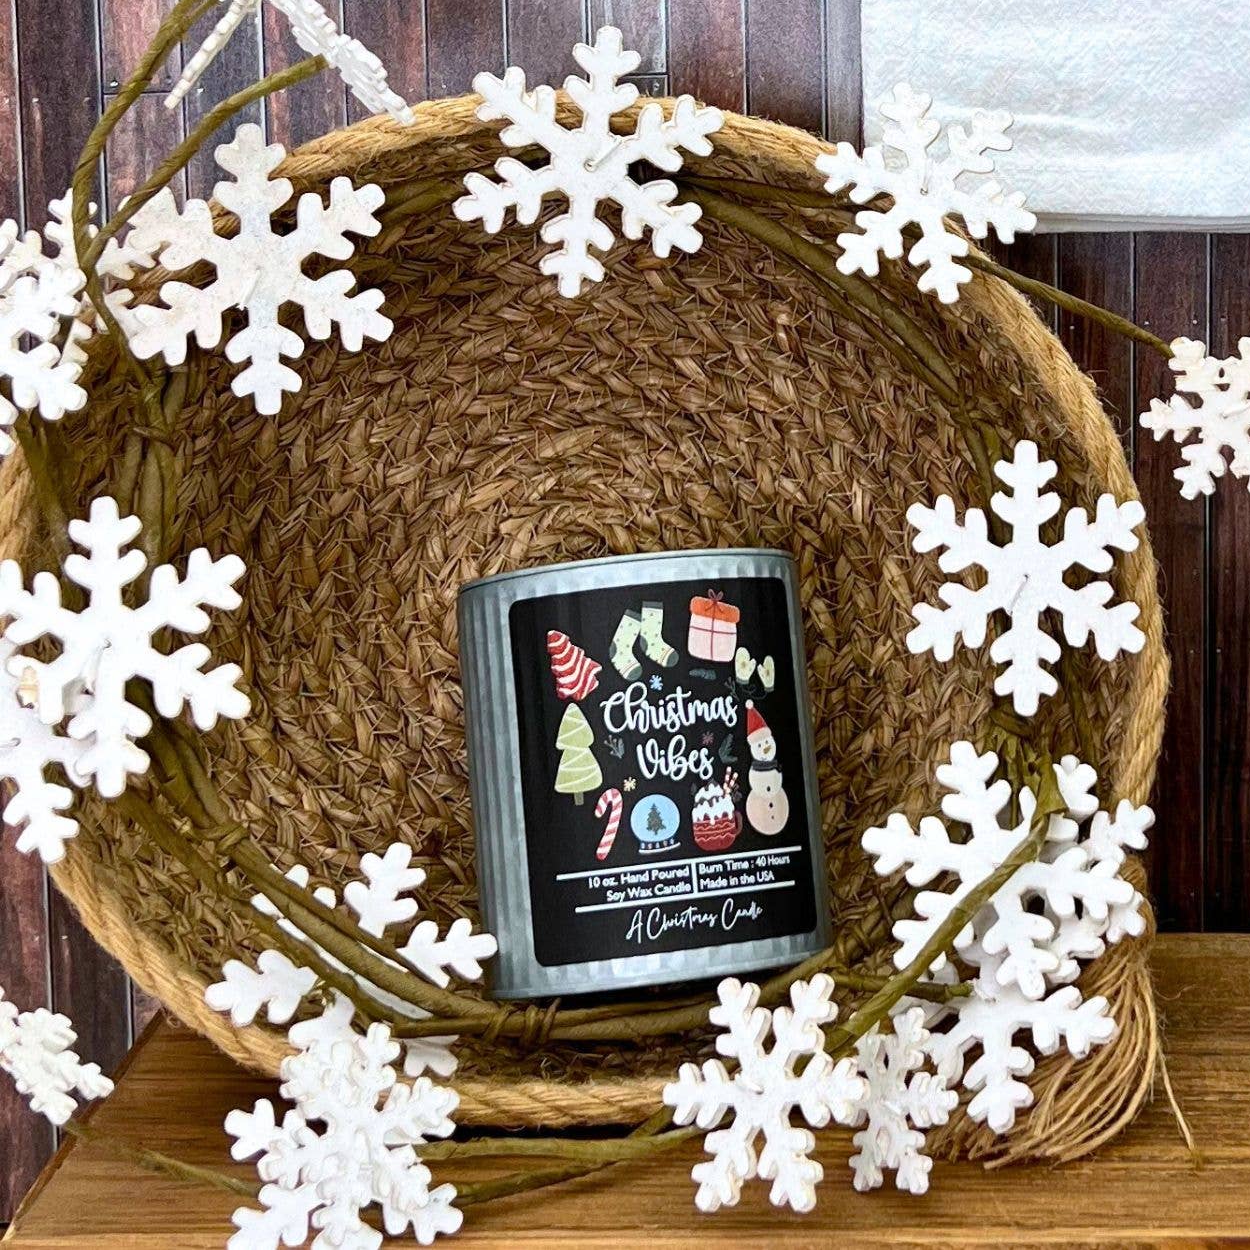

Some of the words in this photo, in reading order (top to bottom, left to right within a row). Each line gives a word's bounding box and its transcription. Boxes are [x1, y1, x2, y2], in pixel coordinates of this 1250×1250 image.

[599, 681, 739, 734] Christmas
[636, 734, 715, 781] Vibes
[698, 863, 723, 875] Burn
[724, 859, 749, 871] Time
[755, 855, 767, 867] 40
[767, 854, 790, 866] Hours
[588, 876, 601, 889] 10
[602, 877, 618, 887] oz.
[620, 870, 650, 884] Hand
[651, 865, 690, 881] Poured
[700, 875, 728, 890] Made
[729, 875, 739, 886] in
[739, 873, 755, 884] the
[756, 870, 775, 882] USA
[606, 889, 626, 902] Soy
[627, 886, 653, 899] Wax
[654, 881, 692, 896] Candle
[625, 909, 643, 944] A
[646, 905, 718, 940] Christmas
